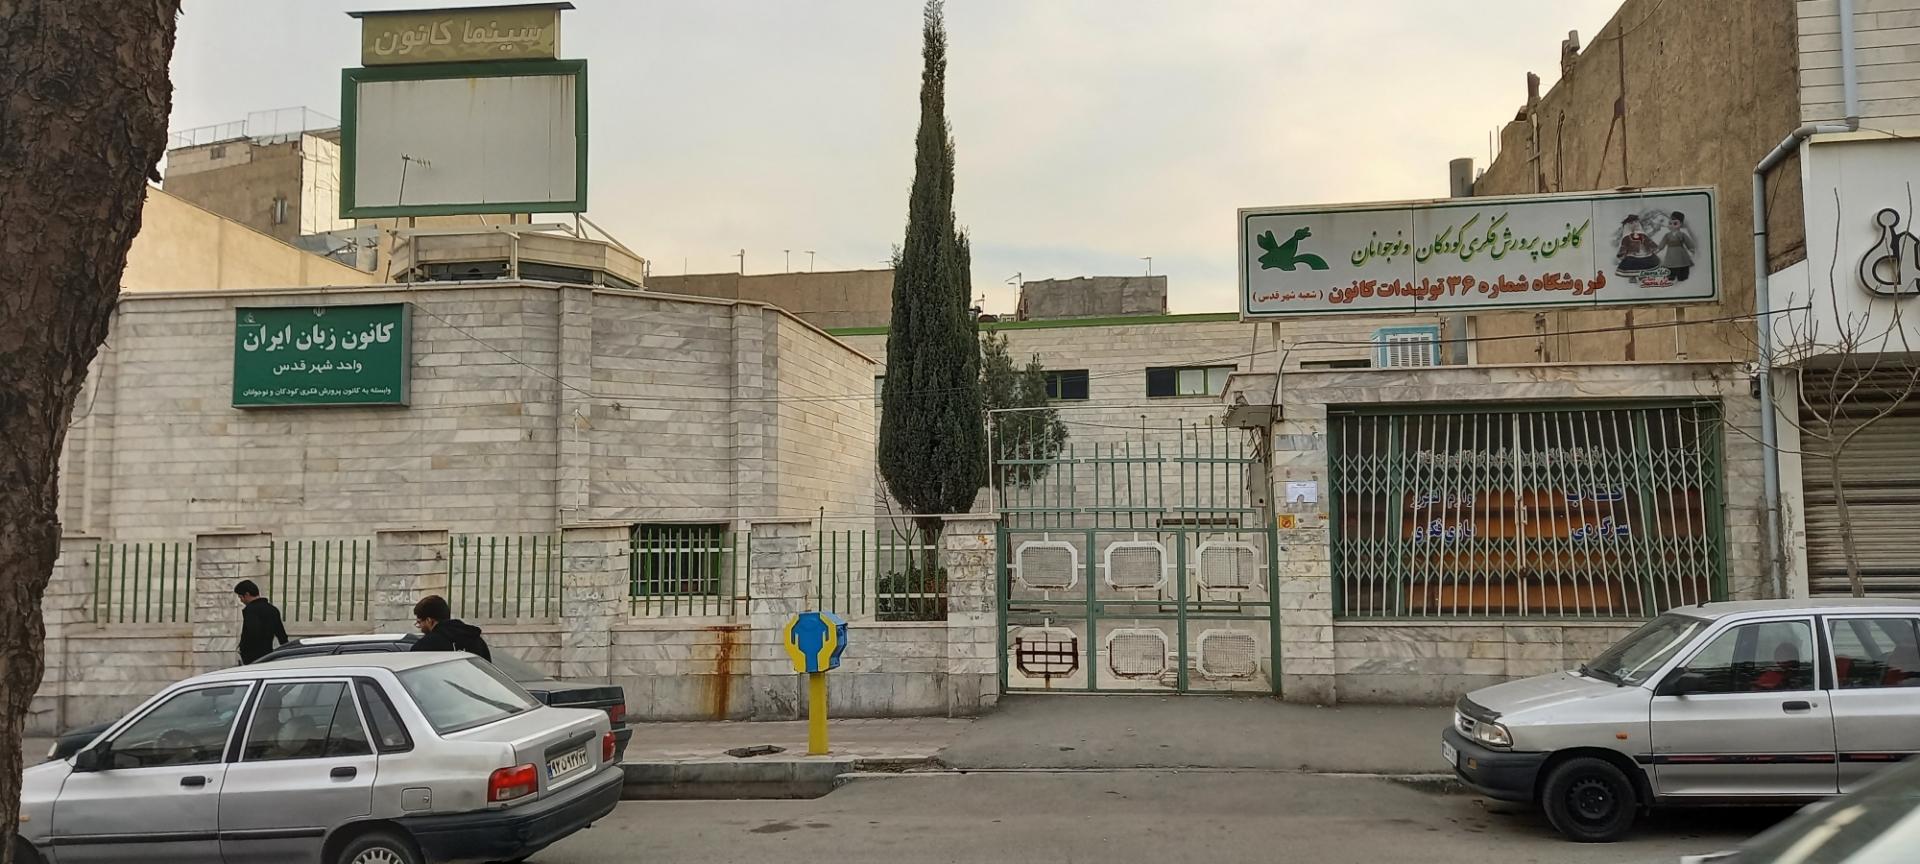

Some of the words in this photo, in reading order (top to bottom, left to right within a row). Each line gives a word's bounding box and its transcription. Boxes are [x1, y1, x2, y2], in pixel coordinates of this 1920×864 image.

[374, 19, 454, 55] کانون
[463, 16, 543, 50] سینما
[1415, 212, 1480, 264] کودکان
[1460, 212, 1508, 262] فکری
[1490, 227, 1539, 262] پرورش
[1541, 218, 1590, 257] کانون
[1329, 279, 1377, 304] کانون
[1377, 277, 1445, 301] تولیدات
[1447, 275, 1476, 296] ۳۶
[1478, 274, 1529, 298] شماره
[1532, 270, 1606, 295] فروشگاه
[1282, 290, 1296, 302] شهر
[243, 324, 291, 351] ایران
[296, 323, 336, 350] زبان
[341, 323, 395, 350] کانون
[273, 360, 306, 375] قدس
[308, 360, 333, 374] شهر
[336, 360, 363, 373] واحد
[243, 388, 269, 398] نوجوانان
[275, 388, 299, 397] کودکان
[300, 387, 318, 397] فکری
[318, 387, 342, 397] پرورش
[343, 387, 361, 396] کانون
[361, 387, 370, 395] به
[370, 386, 391, 396] وابسته
